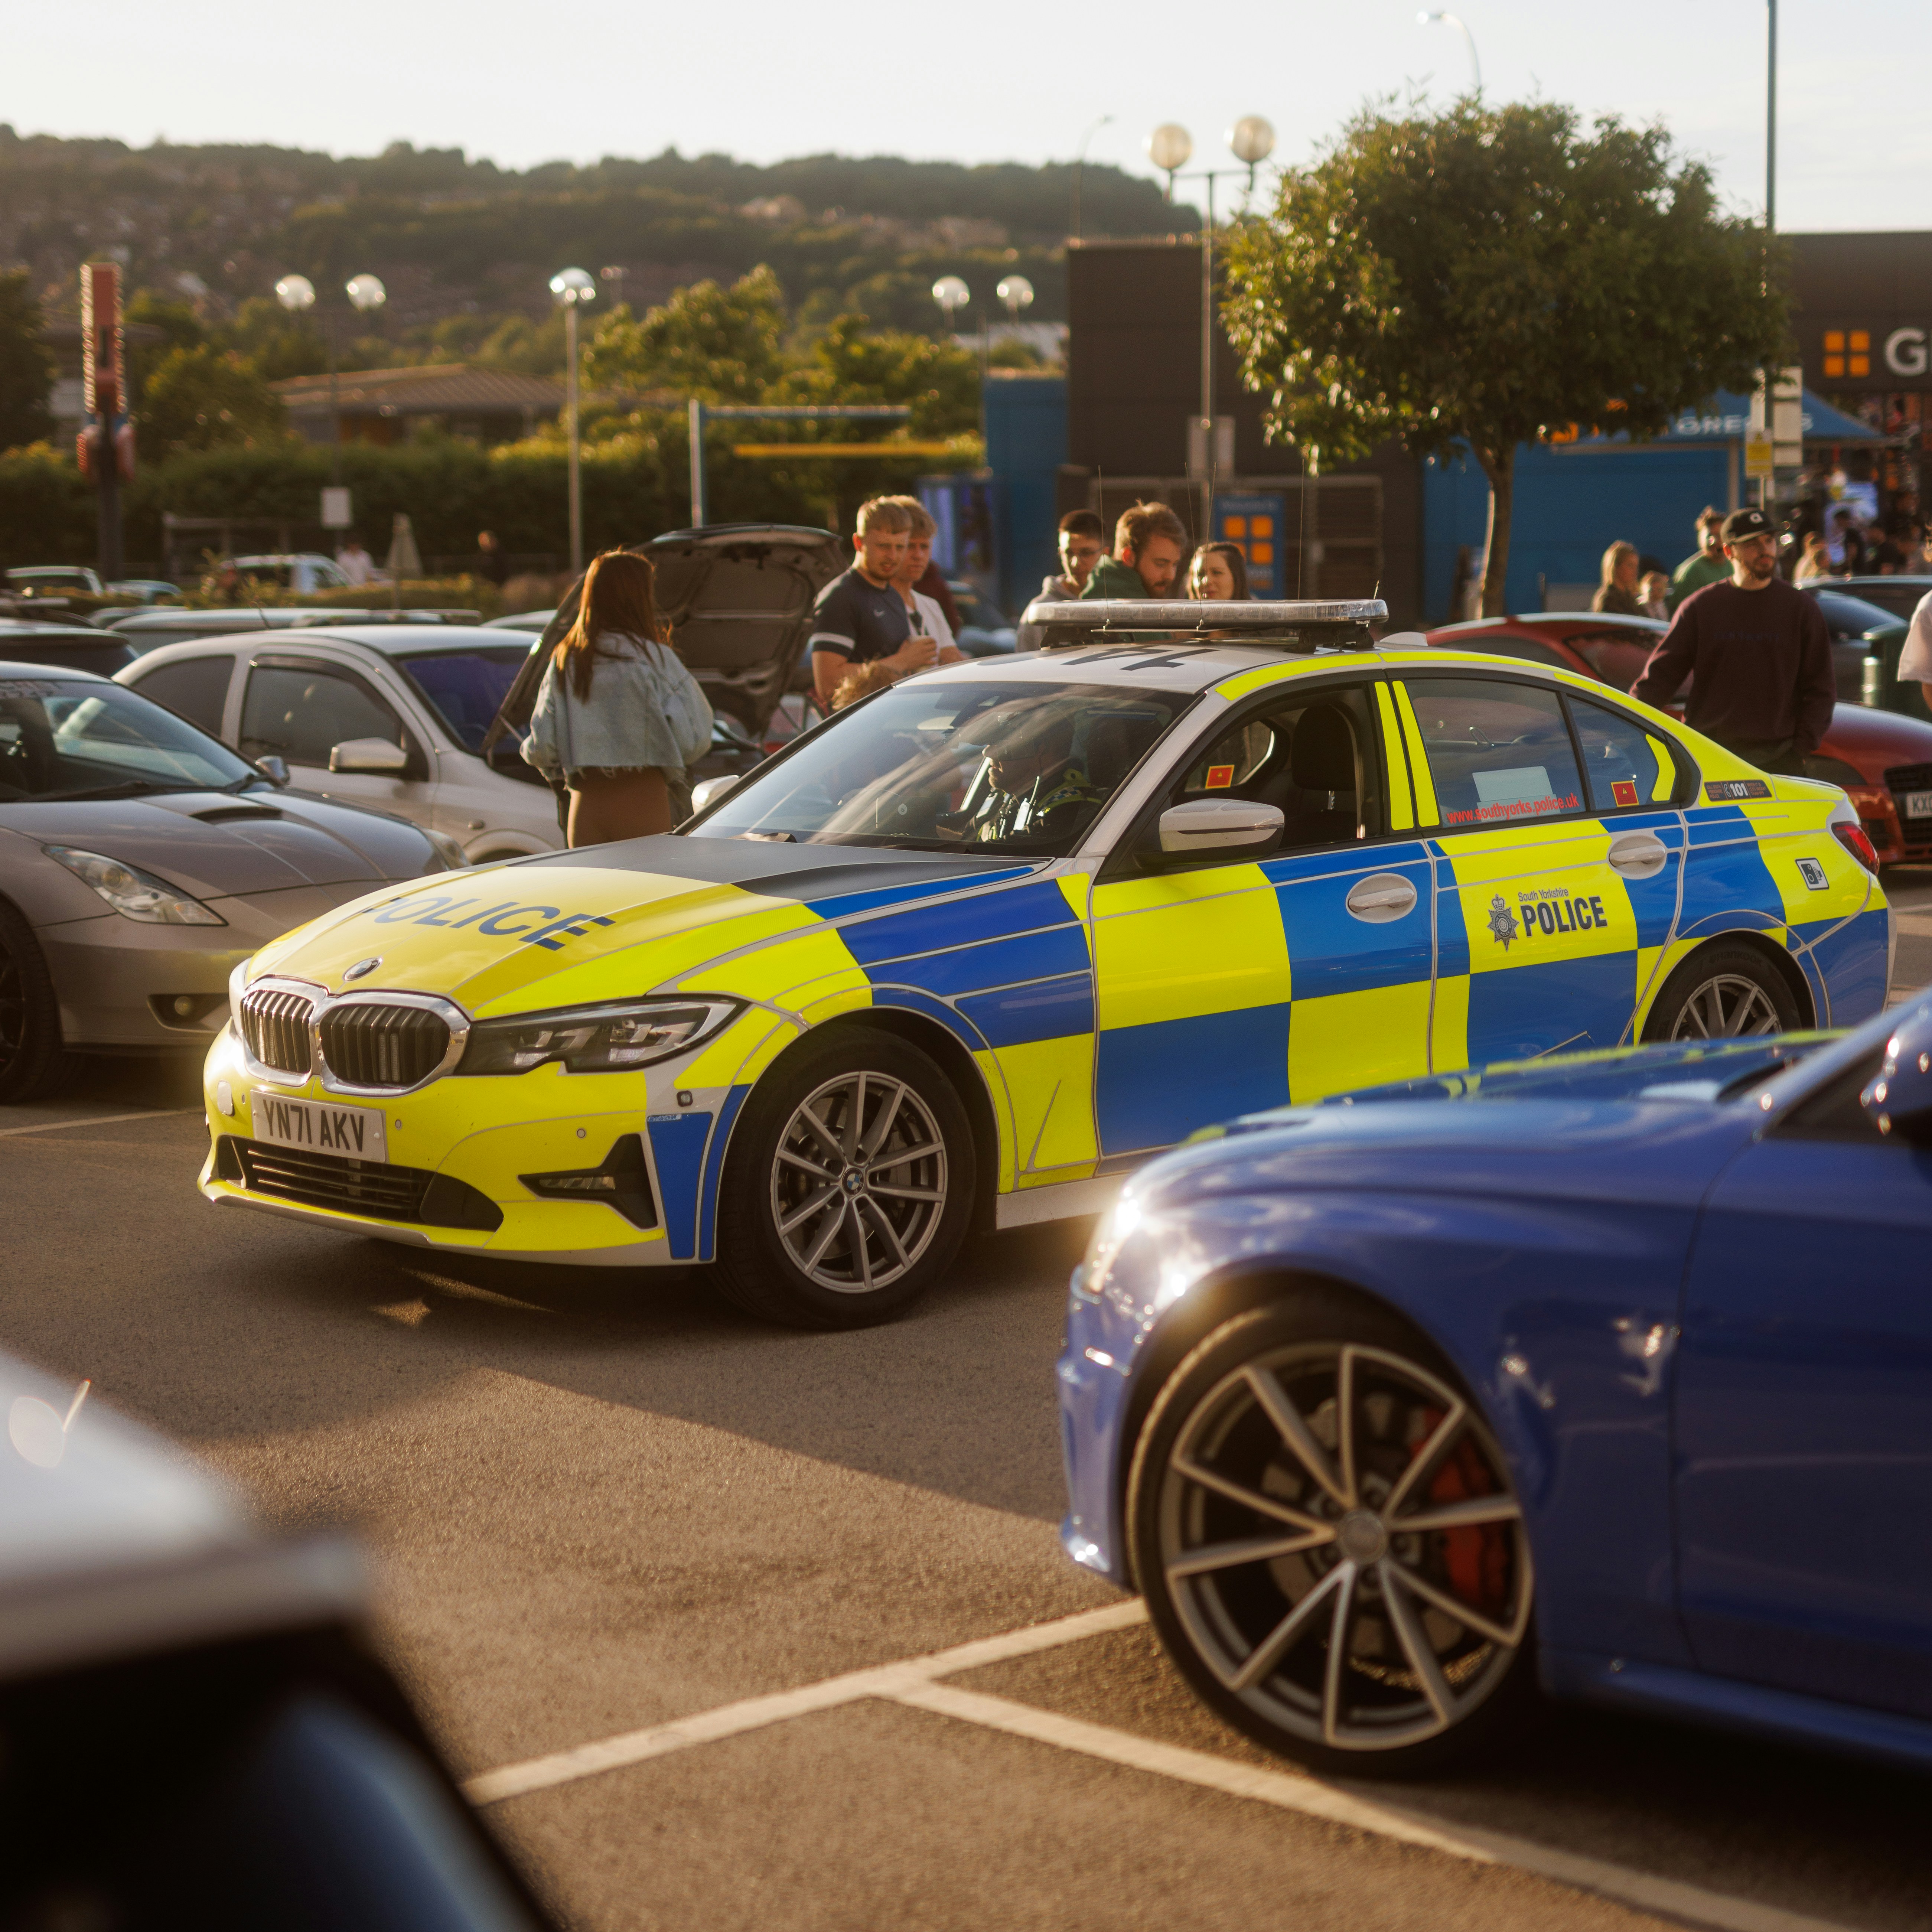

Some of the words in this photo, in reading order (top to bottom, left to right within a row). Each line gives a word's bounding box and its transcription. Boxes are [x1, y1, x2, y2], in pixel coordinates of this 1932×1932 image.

[1676, 413, 1814, 436] GRES
[1730, 783, 1749, 797] 101
[1447, 792, 1579, 824] www.southyorks.police.uk
[1518, 891, 1538, 902] South
[1539, 887, 1569, 899] Yorkshire
[362, 896, 616, 951] POLICE
[1520, 896, 1607, 937] POLICE
[263, 1099, 312, 1144] YN71
[320, 1110, 364, 1152] AKV
